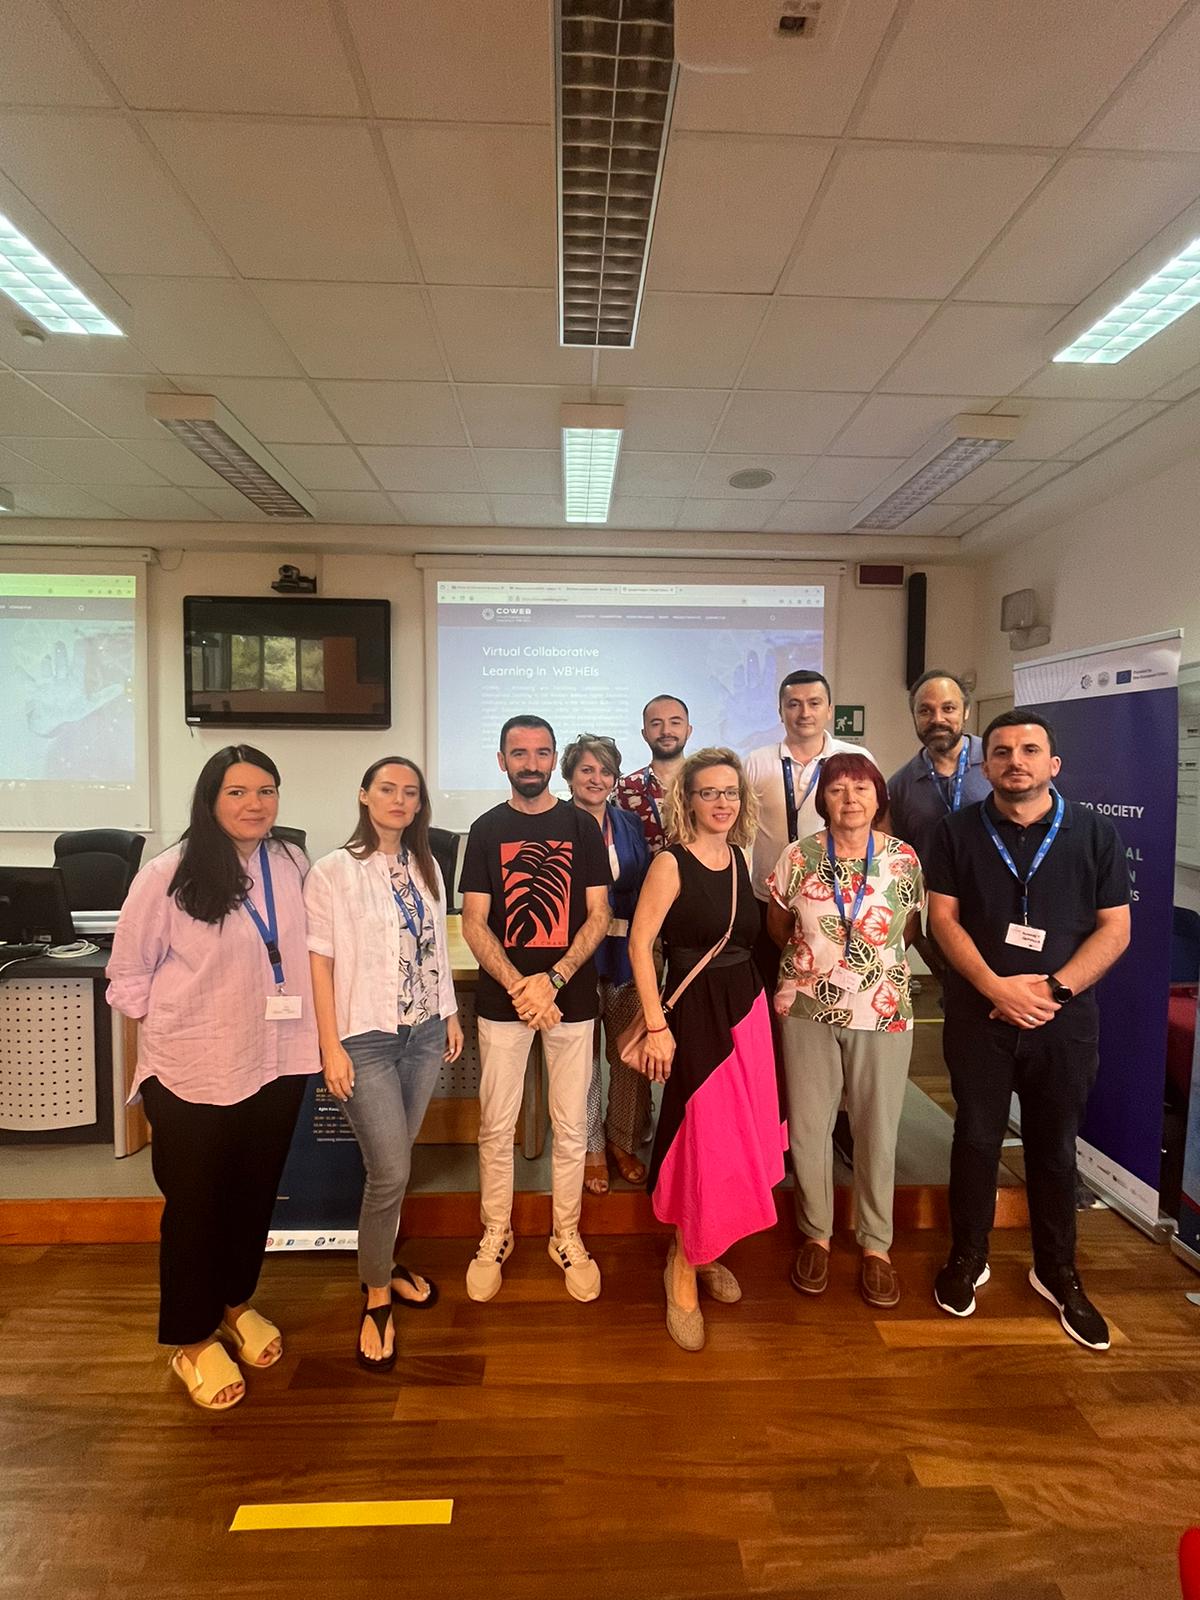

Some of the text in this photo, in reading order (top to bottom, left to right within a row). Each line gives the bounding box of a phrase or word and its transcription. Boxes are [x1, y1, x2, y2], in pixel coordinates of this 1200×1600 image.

[496, 607, 531, 615] COWEB
[482, 646, 600, 657] Virtual Collaborative
[482, 665, 534, 679] Learning
[1096, 803, 1145, 819] SOCIETY
